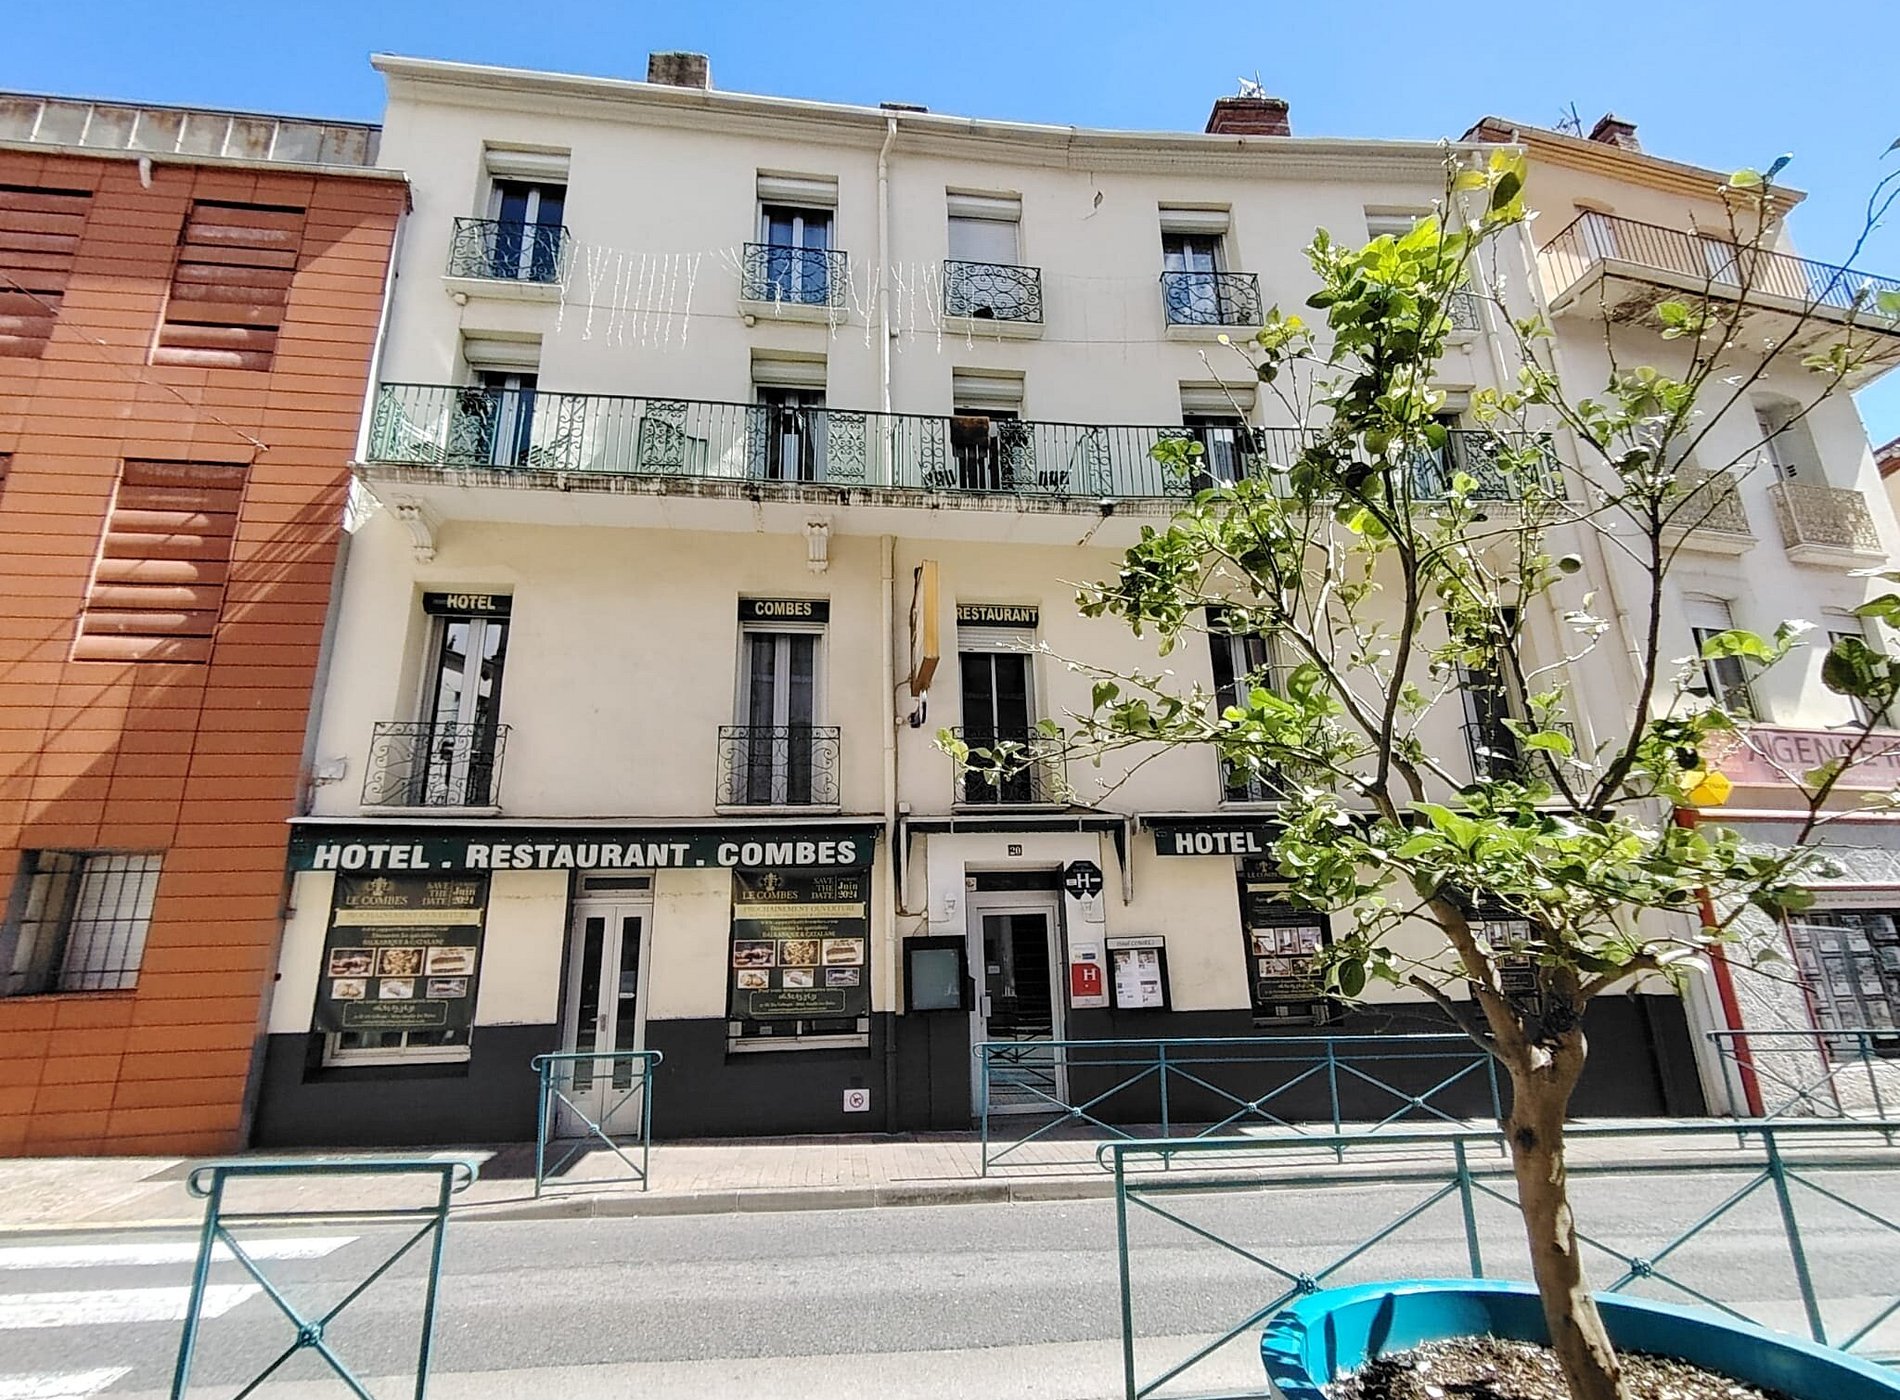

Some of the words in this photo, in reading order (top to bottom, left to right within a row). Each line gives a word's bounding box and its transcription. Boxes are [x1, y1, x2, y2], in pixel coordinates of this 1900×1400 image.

[447, 594, 496, 610] HOTEL
[755, 601, 812, 616] COMBES
[957, 607, 1037, 622] RESTAURANT
[1175, 831, 1263, 855] HOTEL
[312, 844, 430, 869] HOTEL
[465, 843, 691, 869] RESTAURANT
[717, 841, 857, 867] COMBES
[838, 881, 858, 890] Juin
[345, 895, 359, 905] LE
[361, 895, 408, 906] COMBES
[742, 890, 756, 900] LE
[757, 890, 799, 900] COMBES
[811, 891, 834, 900] DATE
[1083, 967, 1097, 981] H
